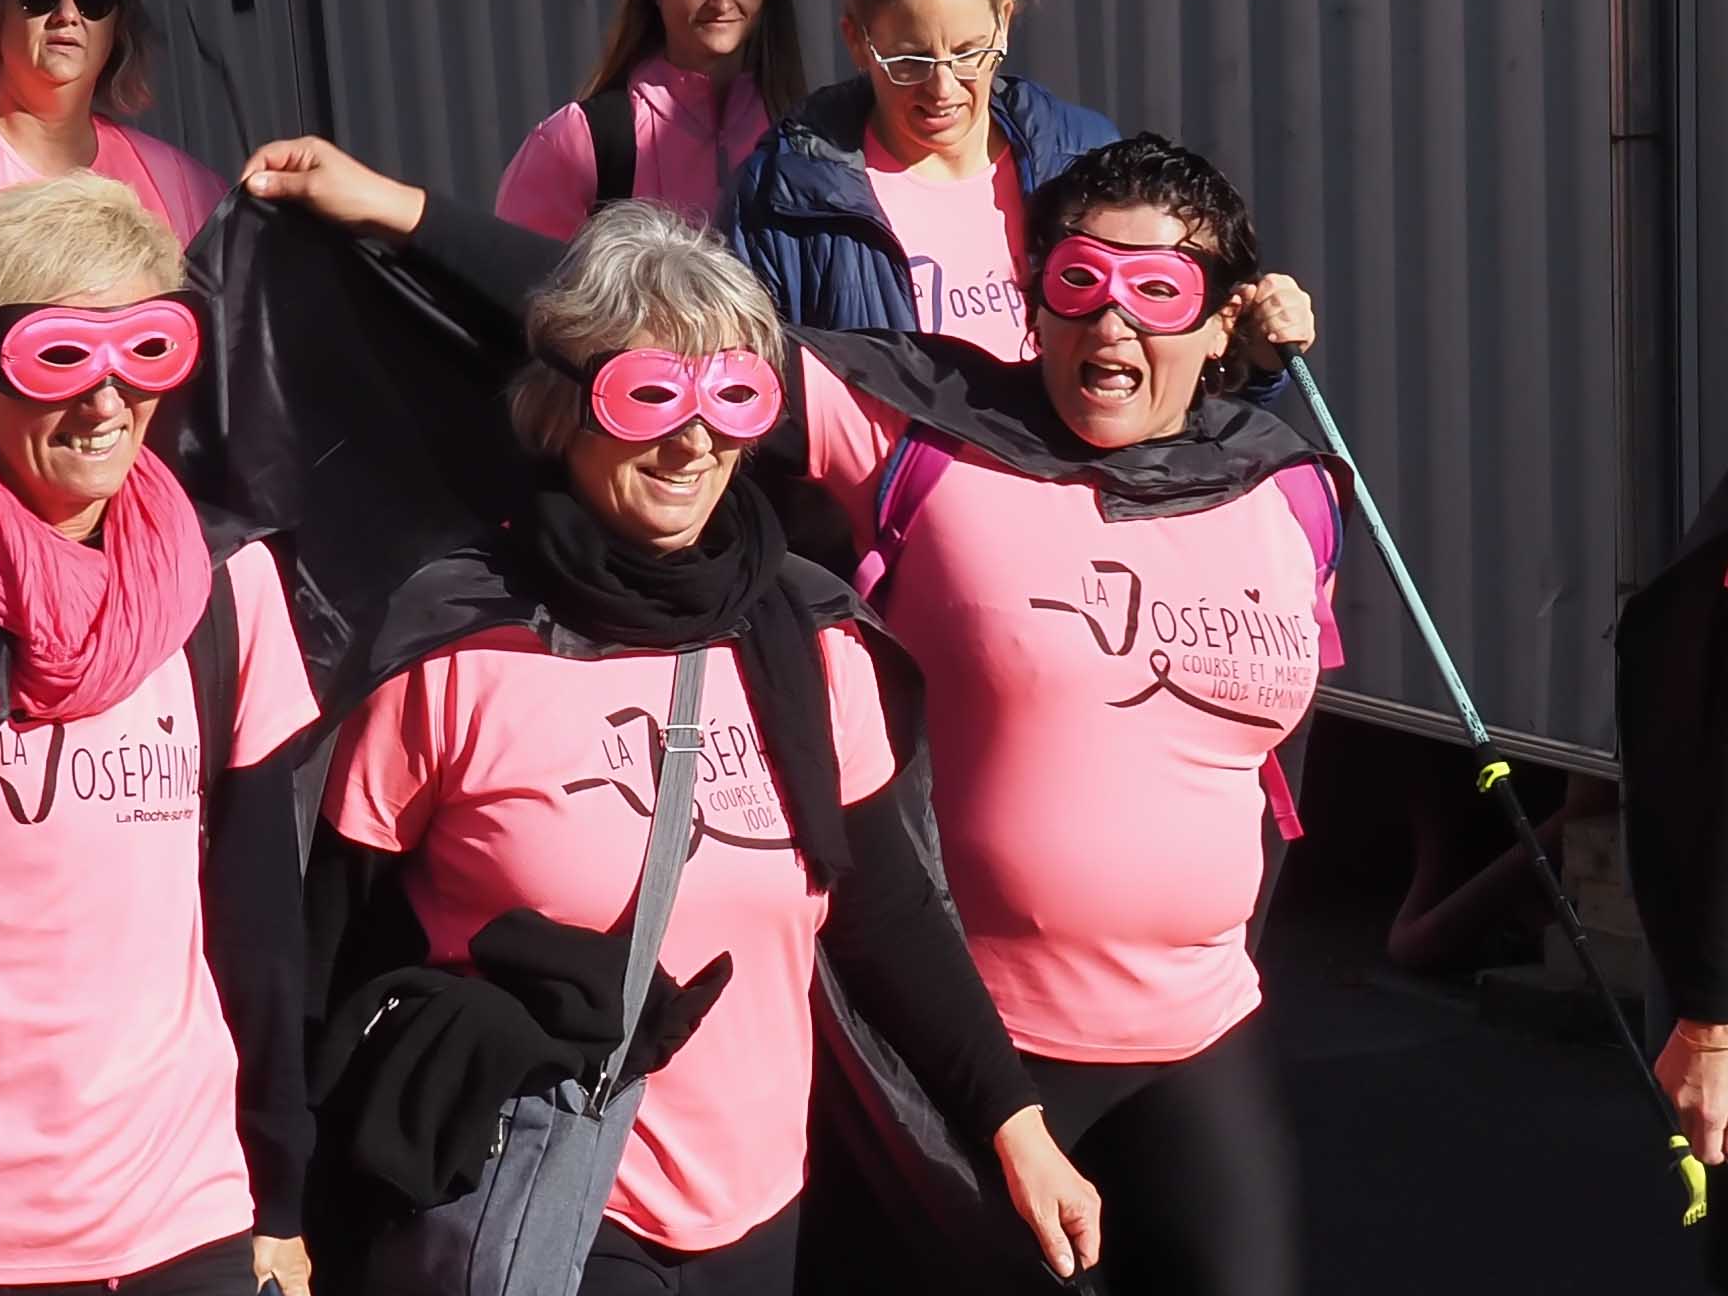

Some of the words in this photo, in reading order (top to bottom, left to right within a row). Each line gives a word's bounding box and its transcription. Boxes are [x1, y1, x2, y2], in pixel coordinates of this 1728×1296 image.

[1081, 575, 1110, 608] LA
[1182, 655, 1240, 681] COURSE
[1249, 662, 1266, 683] ET
[1210, 679, 1249, 703] 100%
[0, 730, 28, 766] LA
[602, 733, 634, 770] LA
[708, 784, 762, 812] COURSE
[763, 782, 776, 802] E
[744, 807, 777, 833] 100%
